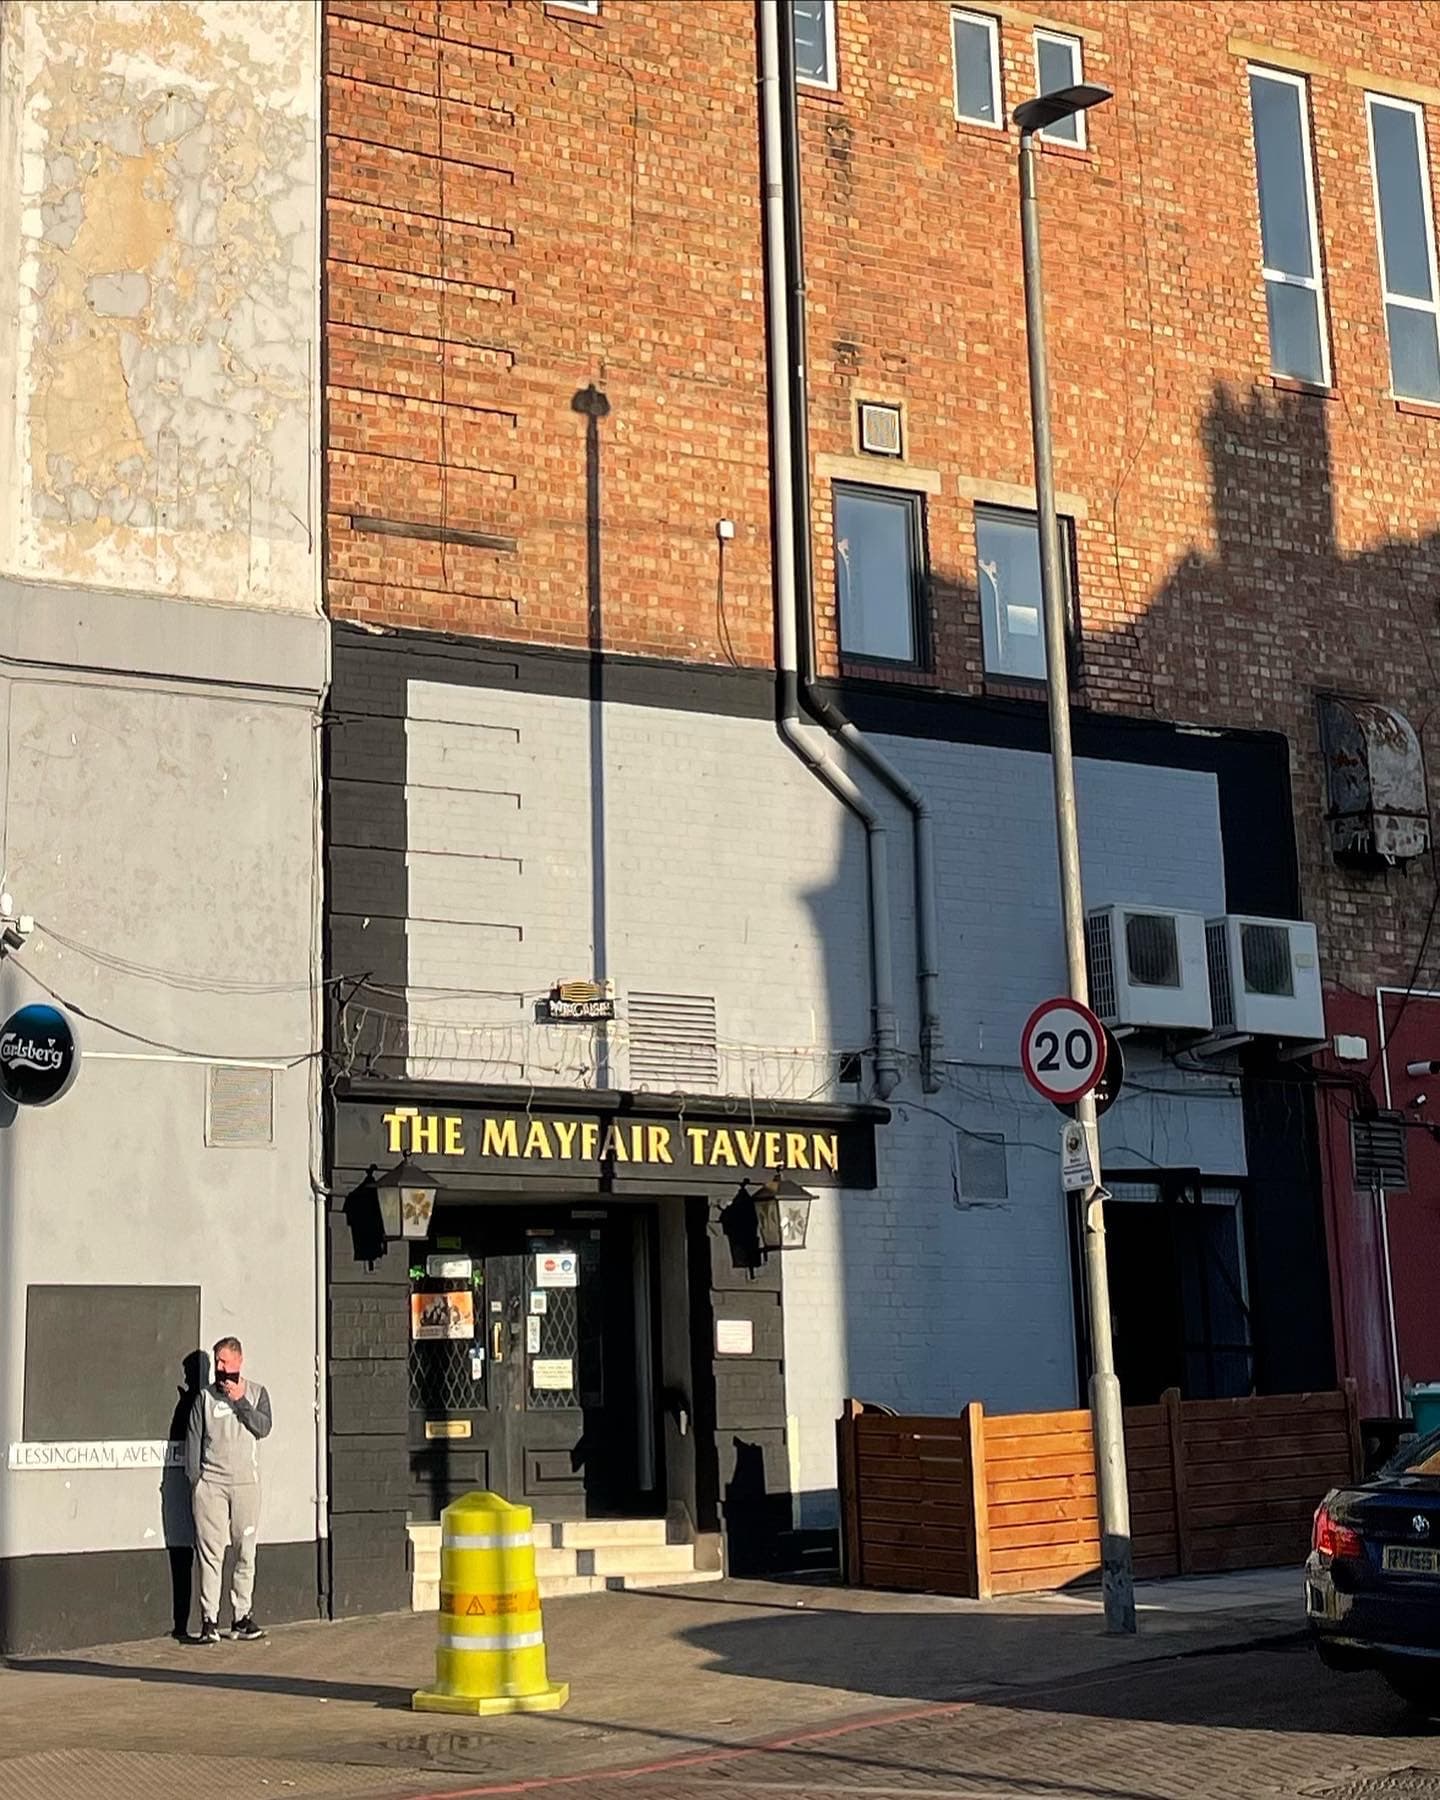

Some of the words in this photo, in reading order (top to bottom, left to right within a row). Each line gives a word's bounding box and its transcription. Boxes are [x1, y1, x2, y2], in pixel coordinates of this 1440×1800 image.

[0, 1032, 63, 1069] Carlsberg
[1035, 1029, 1093, 1072] 20
[383, 1111, 466, 1156] THE
[481, 1118, 673, 1164] MAYFAIR
[686, 1127, 839, 1170] TAVERN
[16, 1446, 115, 1465] LESSINGHAM
[122, 1443, 182, 1463] AVENUE
